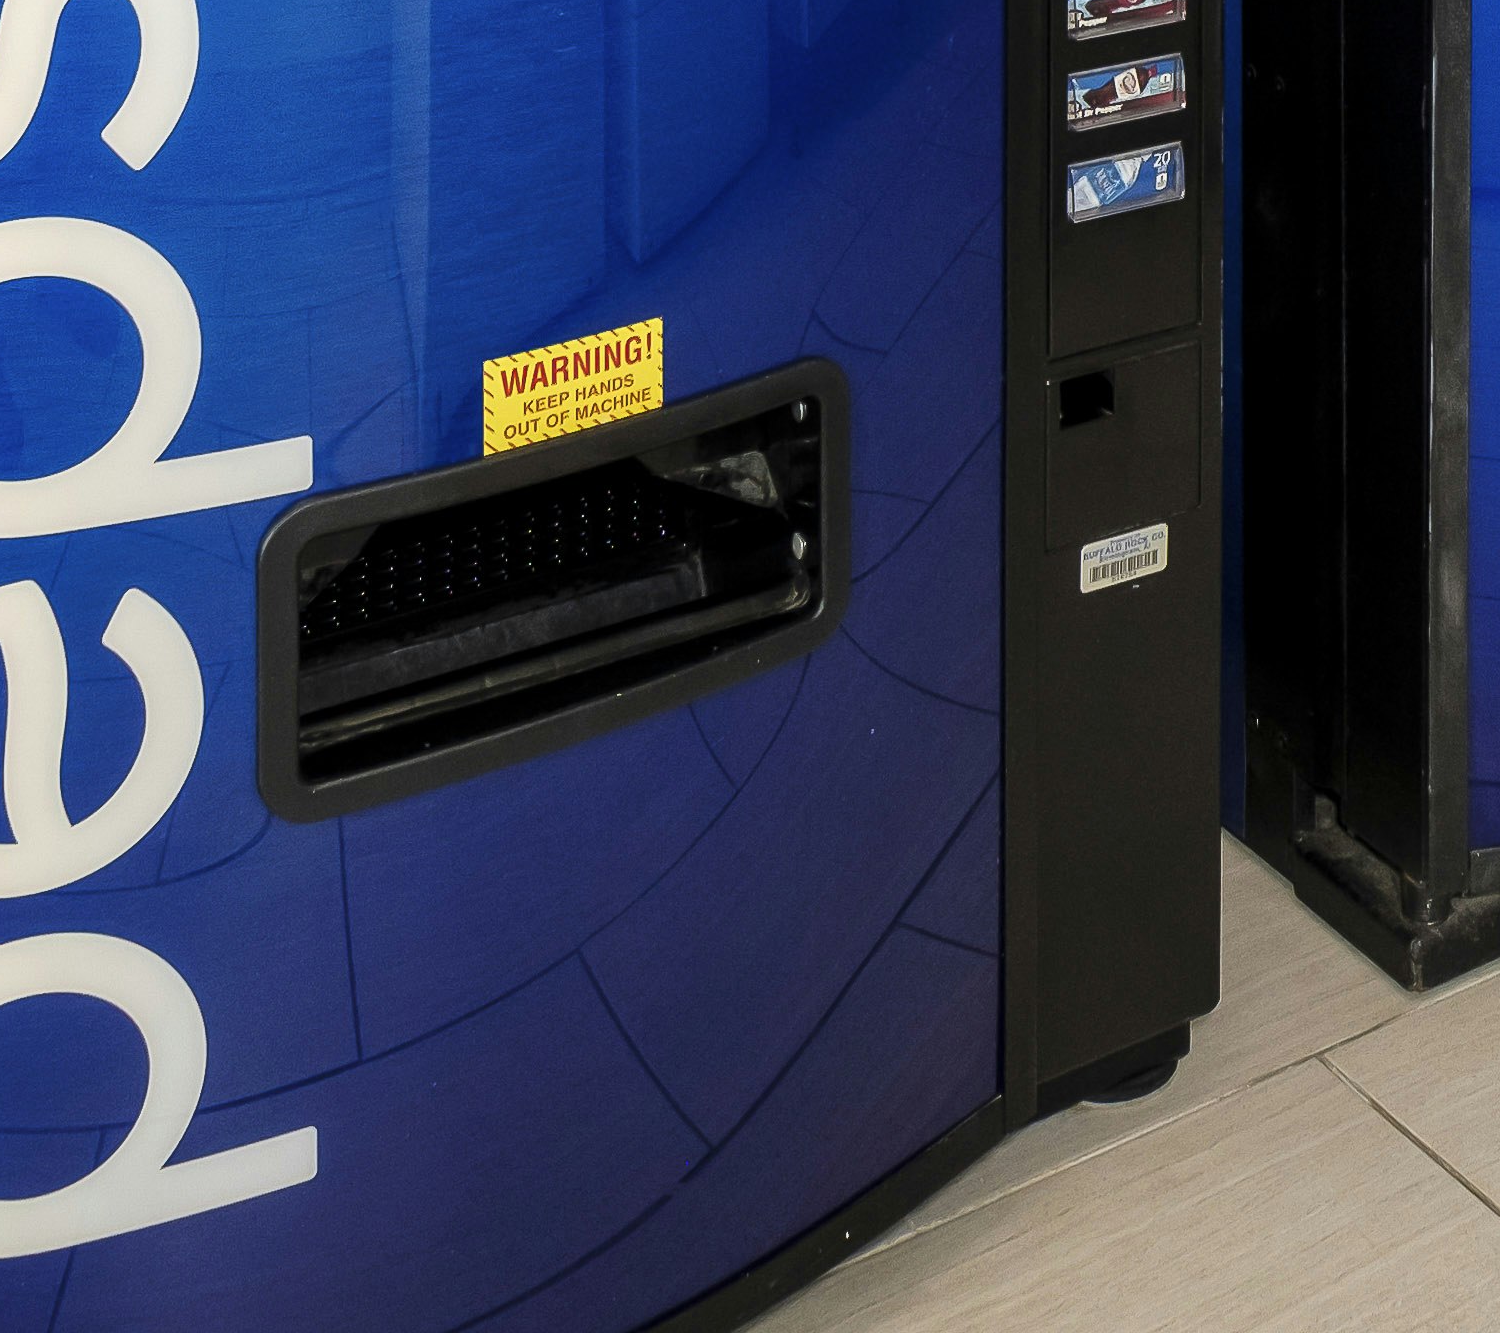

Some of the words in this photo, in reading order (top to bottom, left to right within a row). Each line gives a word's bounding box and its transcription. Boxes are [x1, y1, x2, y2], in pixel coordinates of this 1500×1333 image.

[1153, 150, 1171, 168] 20
[501, 332, 652, 399] WARNING!
[504, 417, 541, 440] OUT
[546, 409, 570, 428] OF
[575, 387, 651, 421] MACHINE
[523, 391, 570, 416] KEEP
[575, 373, 634, 402] HANDS
